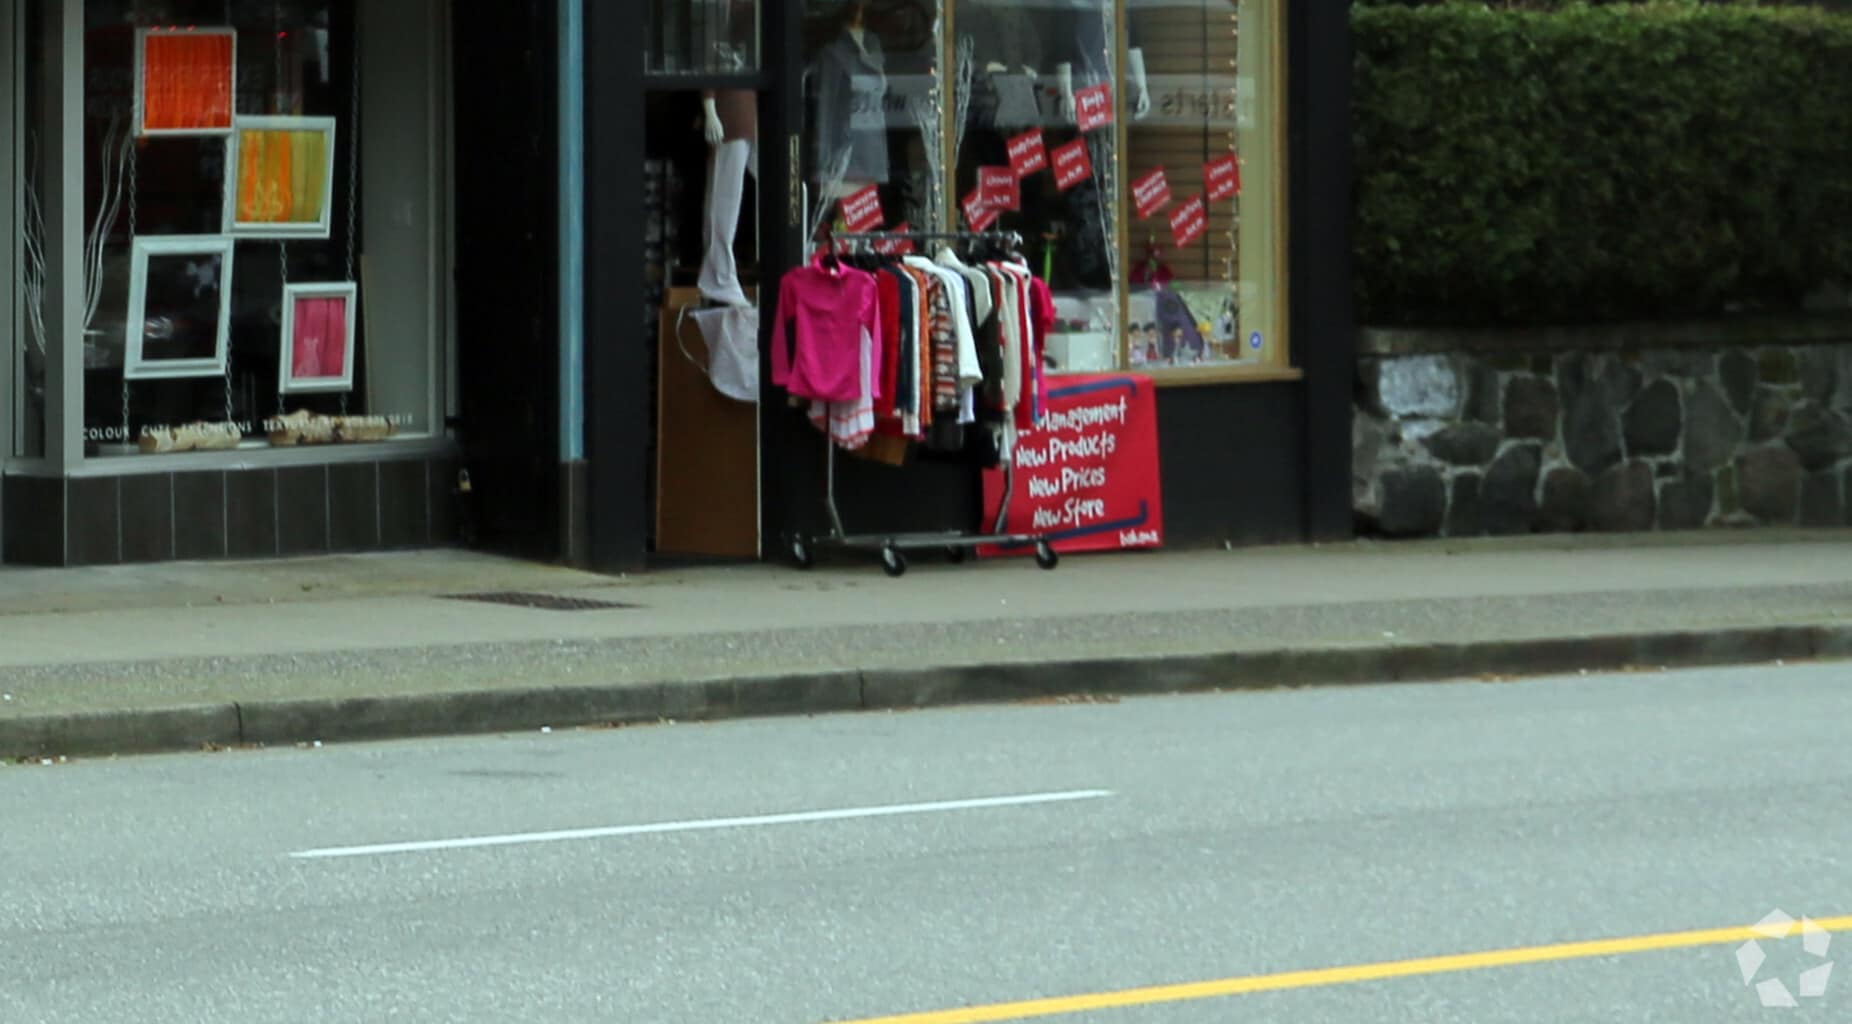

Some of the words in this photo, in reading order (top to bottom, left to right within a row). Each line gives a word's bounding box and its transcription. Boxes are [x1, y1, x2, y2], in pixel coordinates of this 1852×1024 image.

[1016, 444, 1047, 468] New
[1049, 431, 1116, 464] Products
[1029, 474, 1060, 499] New
[1061, 466, 1106, 494] Prices
[1033, 506, 1061, 528] New
[1063, 497, 1105, 527] Store
